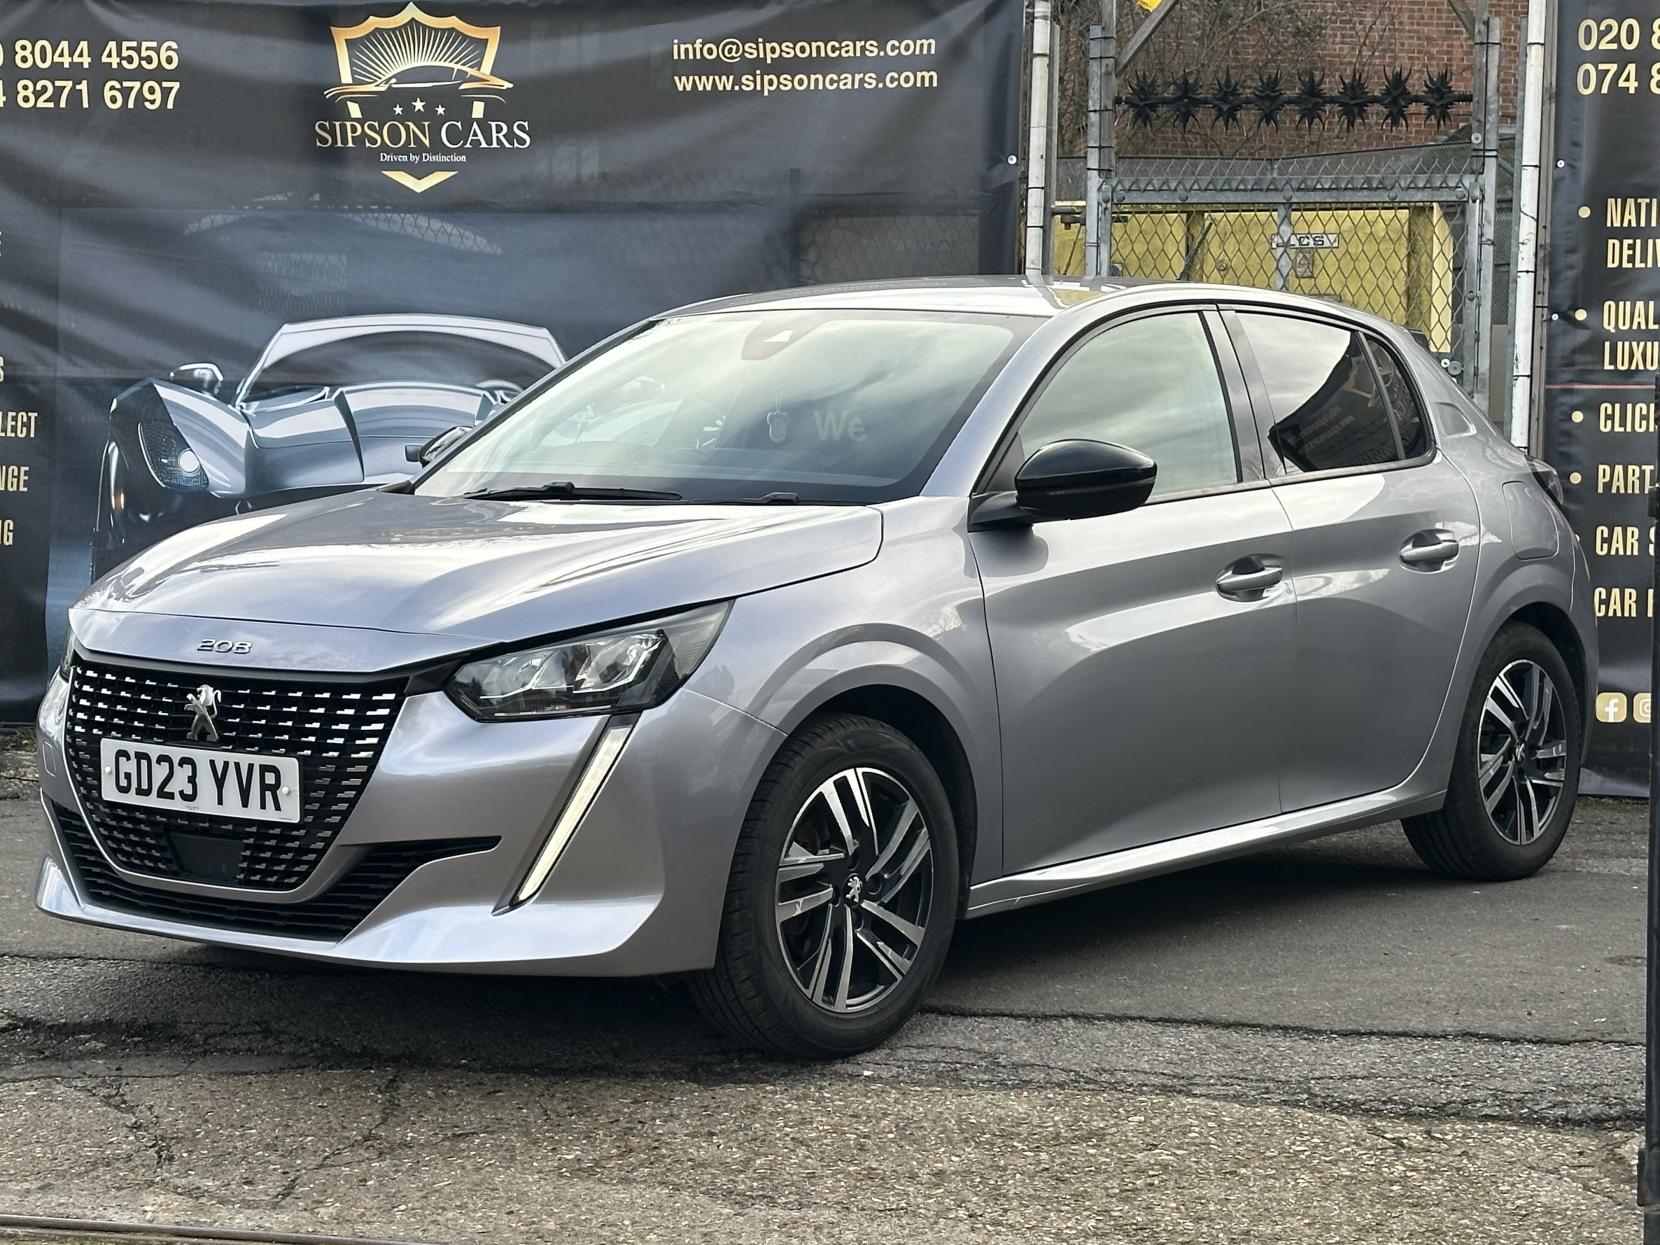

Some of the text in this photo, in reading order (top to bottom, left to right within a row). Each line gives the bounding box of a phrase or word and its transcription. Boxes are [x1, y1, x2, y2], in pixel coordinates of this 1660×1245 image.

[1578, 18, 1640, 51] 020
[14, 39, 92, 69] 8044
[101, 40, 179, 70] 4556
[673, 37, 936, 64] info@sipsoncars.com
[16, 79, 90, 109] 8271
[103, 80, 181, 110] 6797
[674, 69, 938, 97] www.sipsoncars.com
[1576, 62, 1639, 96] 074
[314, 120, 531, 149] SIPSON CARS
[380, 152, 467, 164] Driven by Distinction
[1603, 300, 1659, 333] QUAL
[1603, 341, 1659, 371] LUXU
[812, 408, 867, 442] We
[1597, 464, 1655, 494] PART
[1595, 525, 1640, 556] CAR
[1593, 587, 1638, 618] CAR
[196, 638, 252, 655] 208
[113, 749, 283, 812] GD23 YVR
